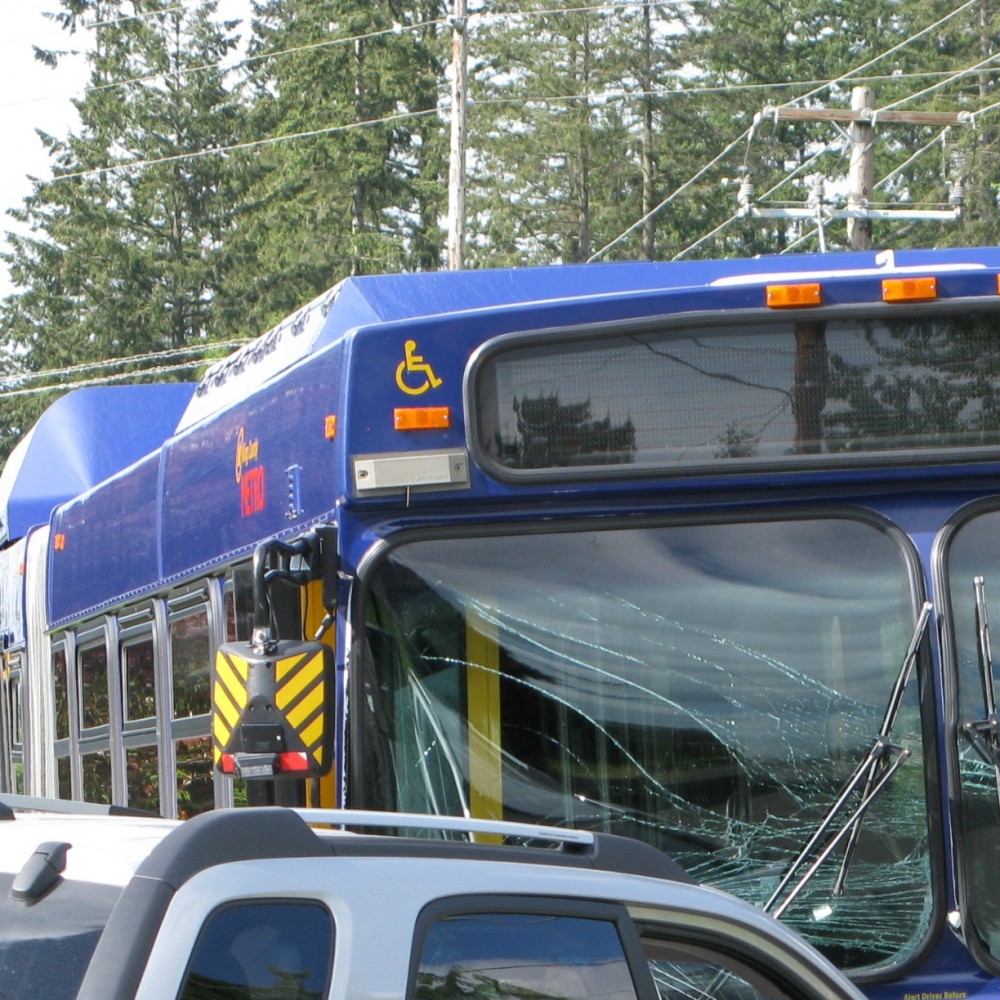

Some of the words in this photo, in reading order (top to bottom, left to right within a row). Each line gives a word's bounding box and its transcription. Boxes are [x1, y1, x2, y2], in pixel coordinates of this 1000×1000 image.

[904, 993, 920, 1000] Alert
[921, 992, 942, 1000] Driver
[943, 991, 967, 999] Before
